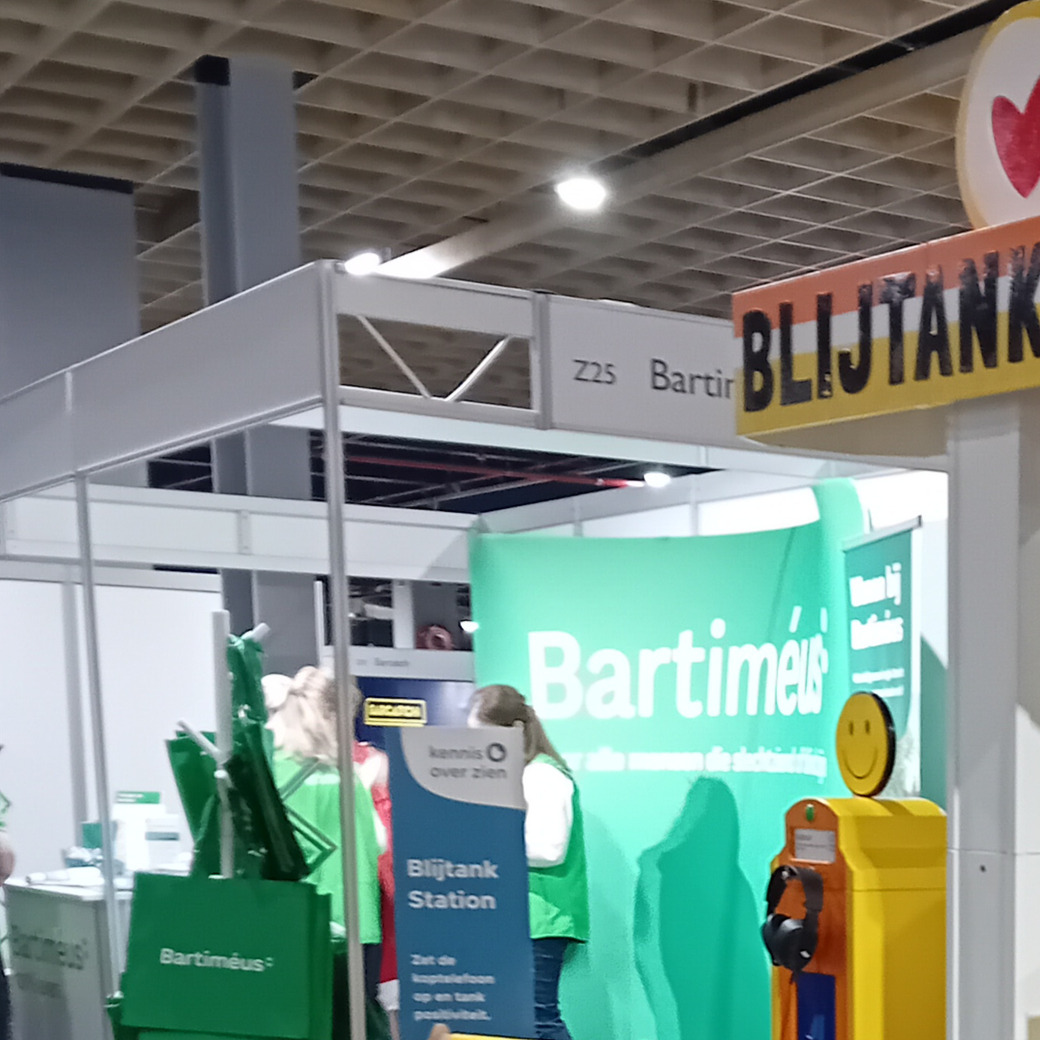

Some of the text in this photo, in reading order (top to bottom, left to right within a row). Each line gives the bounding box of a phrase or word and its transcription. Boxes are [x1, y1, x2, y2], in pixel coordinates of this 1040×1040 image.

[573, 359, 617, 385] Z25
[429, 746, 483, 760] kennis
[430, 764, 508, 779] over zien
[407, 858, 499, 882] Blijtank
[408, 890, 497, 910] Station
